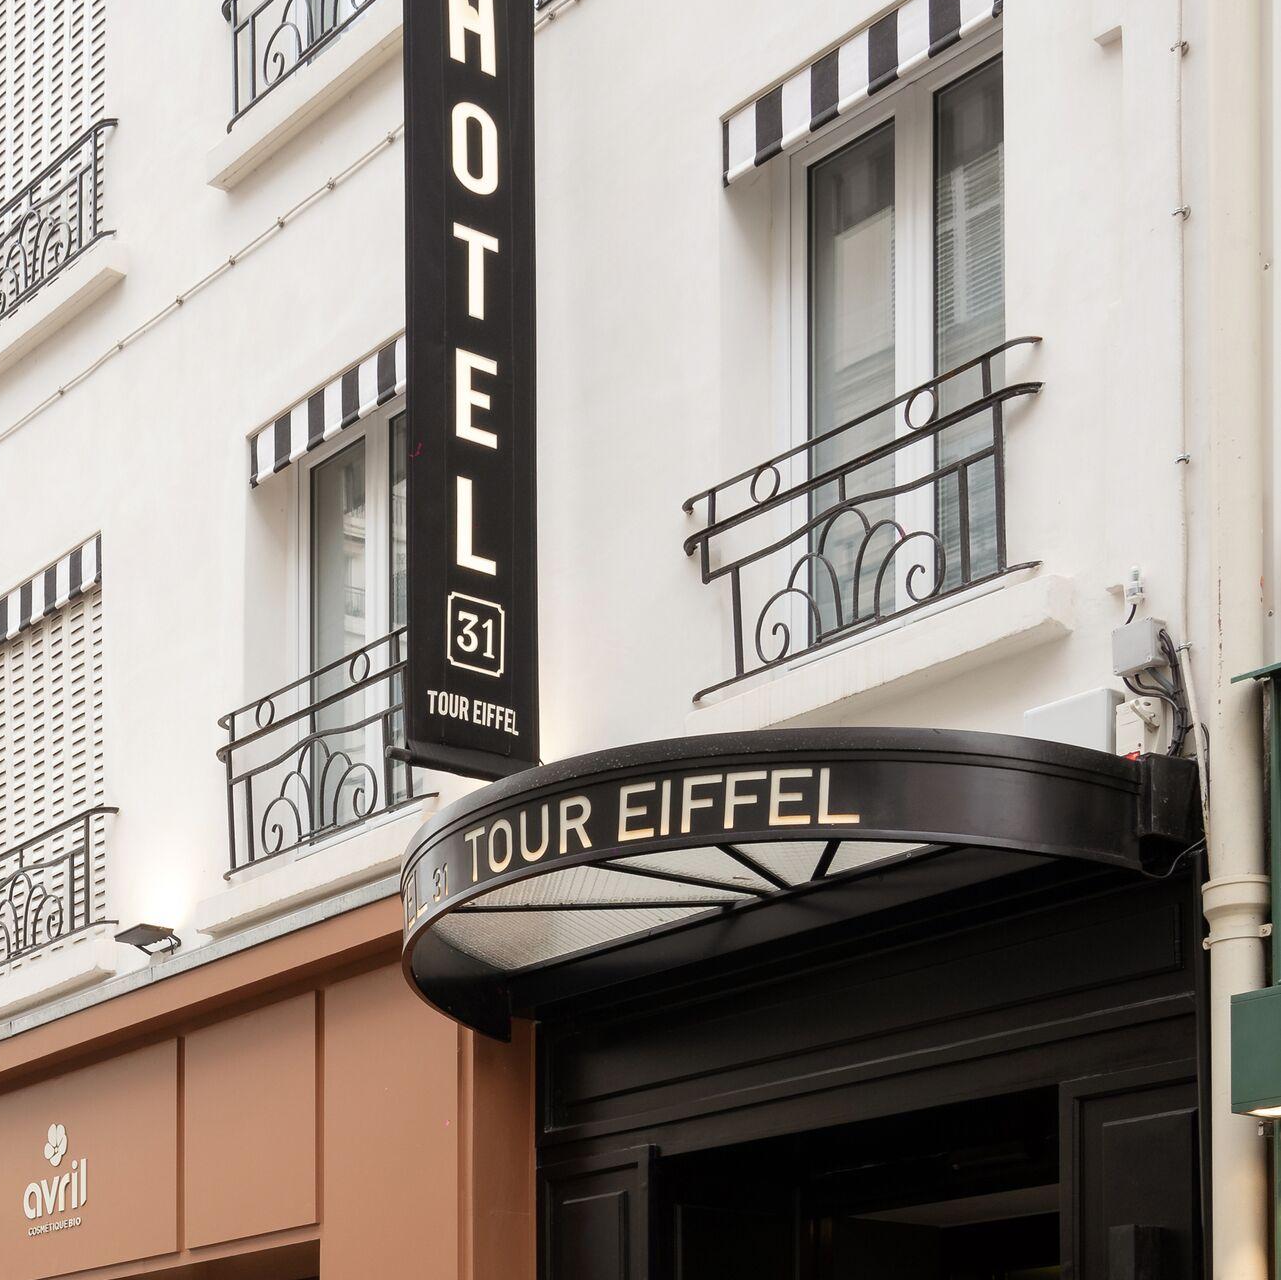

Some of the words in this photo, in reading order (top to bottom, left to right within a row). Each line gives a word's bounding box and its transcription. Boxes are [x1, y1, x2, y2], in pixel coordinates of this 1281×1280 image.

[456, 610, 496, 660] 31
[426, 689, 469, 722] TOUR
[472, 699, 519, 737] EIFFEL
[432, 862, 449, 903] 31
[463, 794, 593, 882] TOUR
[617, 767, 861, 843] EIFFEL
[23, 1158, 88, 1220] avril
[68, 1217, 83, 1228] BIO
